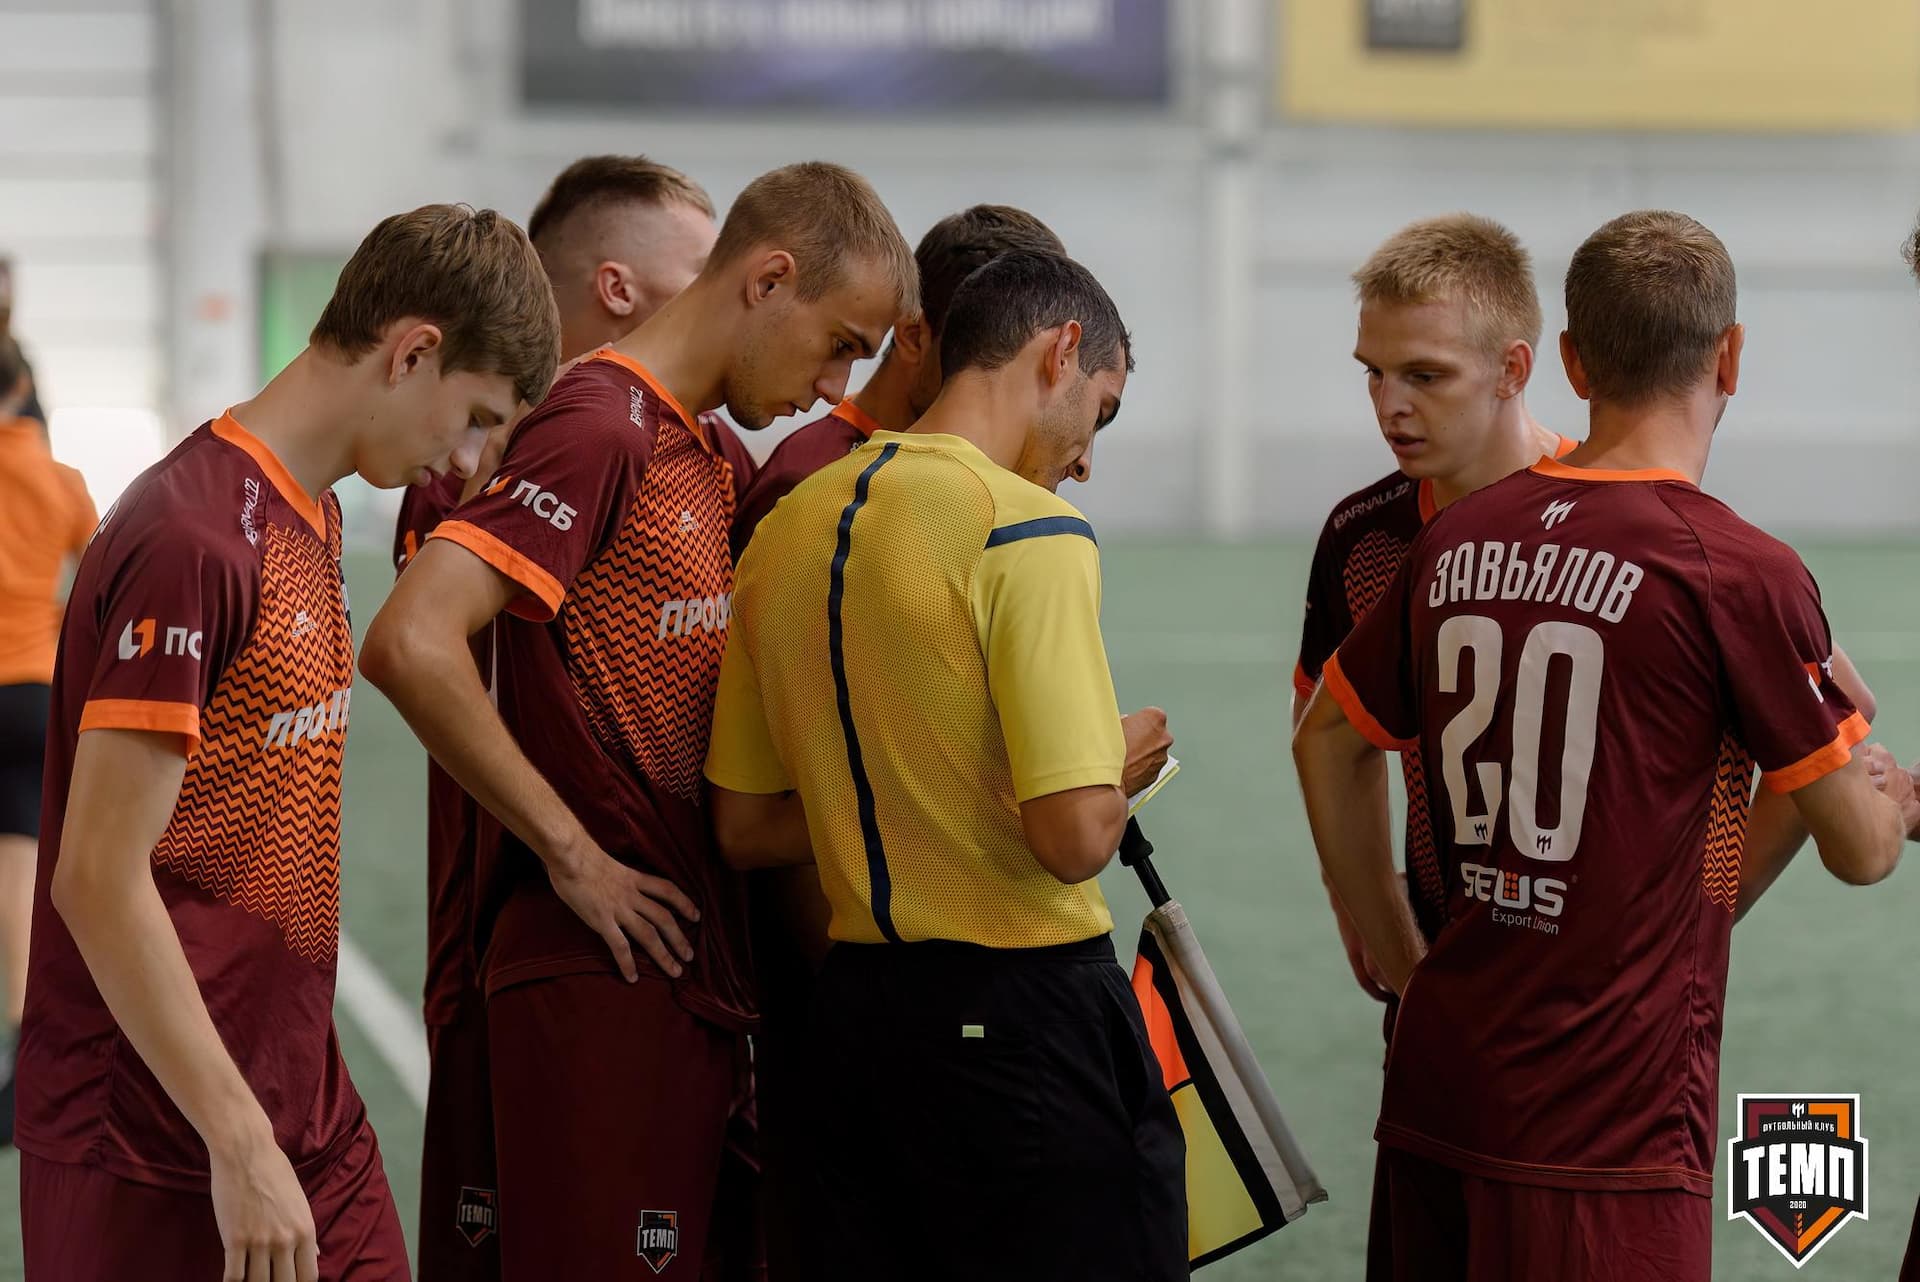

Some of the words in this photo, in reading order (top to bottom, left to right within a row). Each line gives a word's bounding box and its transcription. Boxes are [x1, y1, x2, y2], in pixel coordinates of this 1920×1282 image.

[509, 479, 579, 532] ПСБ
[1428, 541, 1645, 624] ЗАВЬЯЛОВ
[164, 626, 203, 660] ПС
[1436, 614, 1605, 862] 20
[1491, 907, 1532, 927] Export
[460, 1204, 492, 1227] ТЕМП
[642, 1228, 674, 1250] ТЕМП
